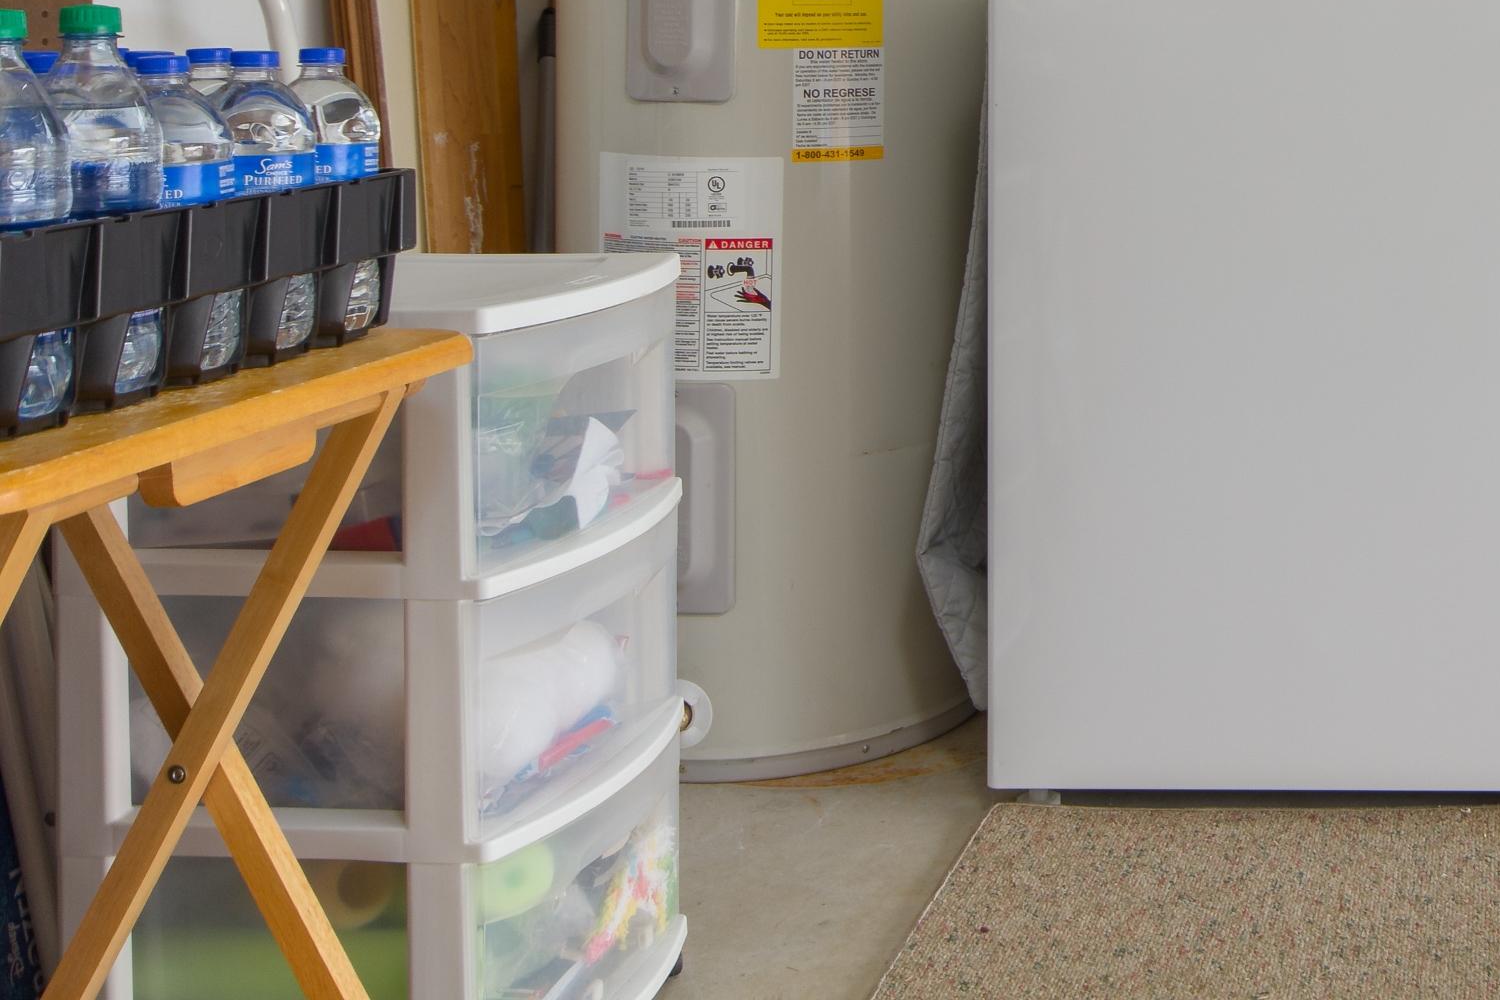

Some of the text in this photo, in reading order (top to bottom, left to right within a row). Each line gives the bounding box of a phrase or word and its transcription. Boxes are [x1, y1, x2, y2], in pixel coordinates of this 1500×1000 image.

[799, 49, 880, 60] DO NOT RETURN
[803, 87, 876, 99] NO REGRESE
[254, 158, 293, 175] Sam's
[721, 241, 769, 249] DANGER
